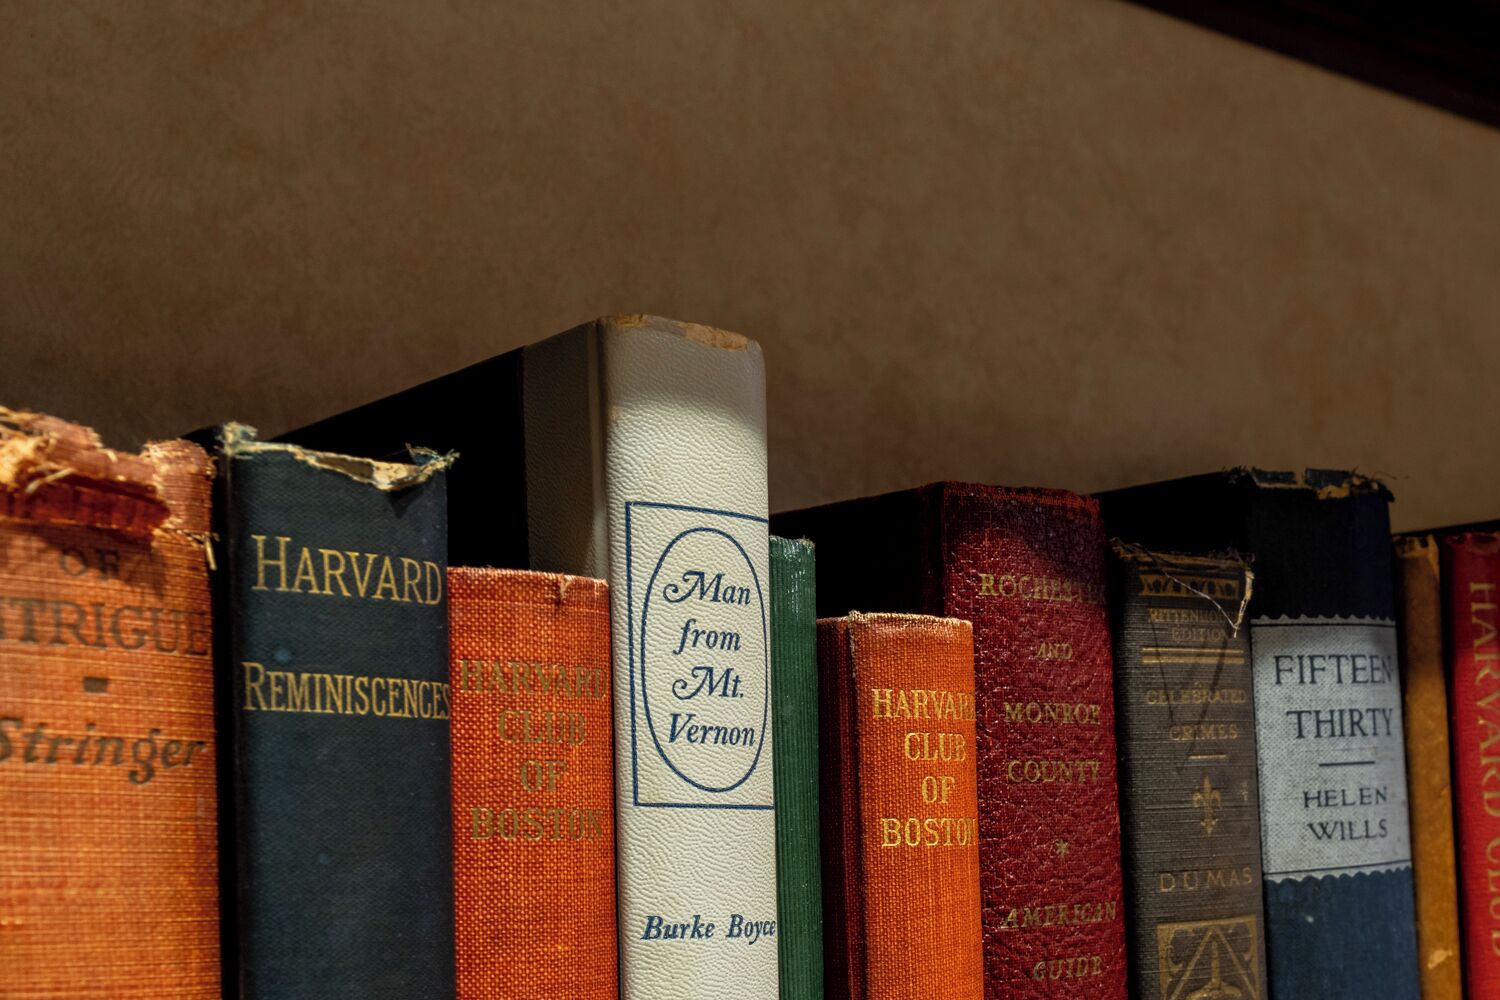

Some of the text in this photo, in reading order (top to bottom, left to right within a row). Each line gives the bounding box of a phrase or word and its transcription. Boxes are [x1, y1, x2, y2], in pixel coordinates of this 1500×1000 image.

[251, 533, 443, 606] HARVARD
[663, 569, 751, 605] Man
[0, 596, 209, 657] TRIGUE
[673, 618, 742, 655] from
[241, 661, 450, 720] REMINISCENCES
[458, 657, 608, 701] HARVARD
[672, 666, 744, 701] Mt.
[499, 709, 587, 746] CLUB
[668, 713, 756, 747] Vernon
[1169, 724, 1239, 742] CRIMES
[1286, 708, 1394, 739] THIRTY
[904, 732, 966, 762] CLUB
[520, 759, 569, 793] OF
[921, 776, 956, 804] OF
[1303, 786, 1388, 809] HELEN
[471, 807, 605, 842] BOSTON
[1307, 818, 1389, 841] WILLS
[1158, 867, 1253, 893] DUMAS
[640, 913, 777, 945] Burke Boyce
